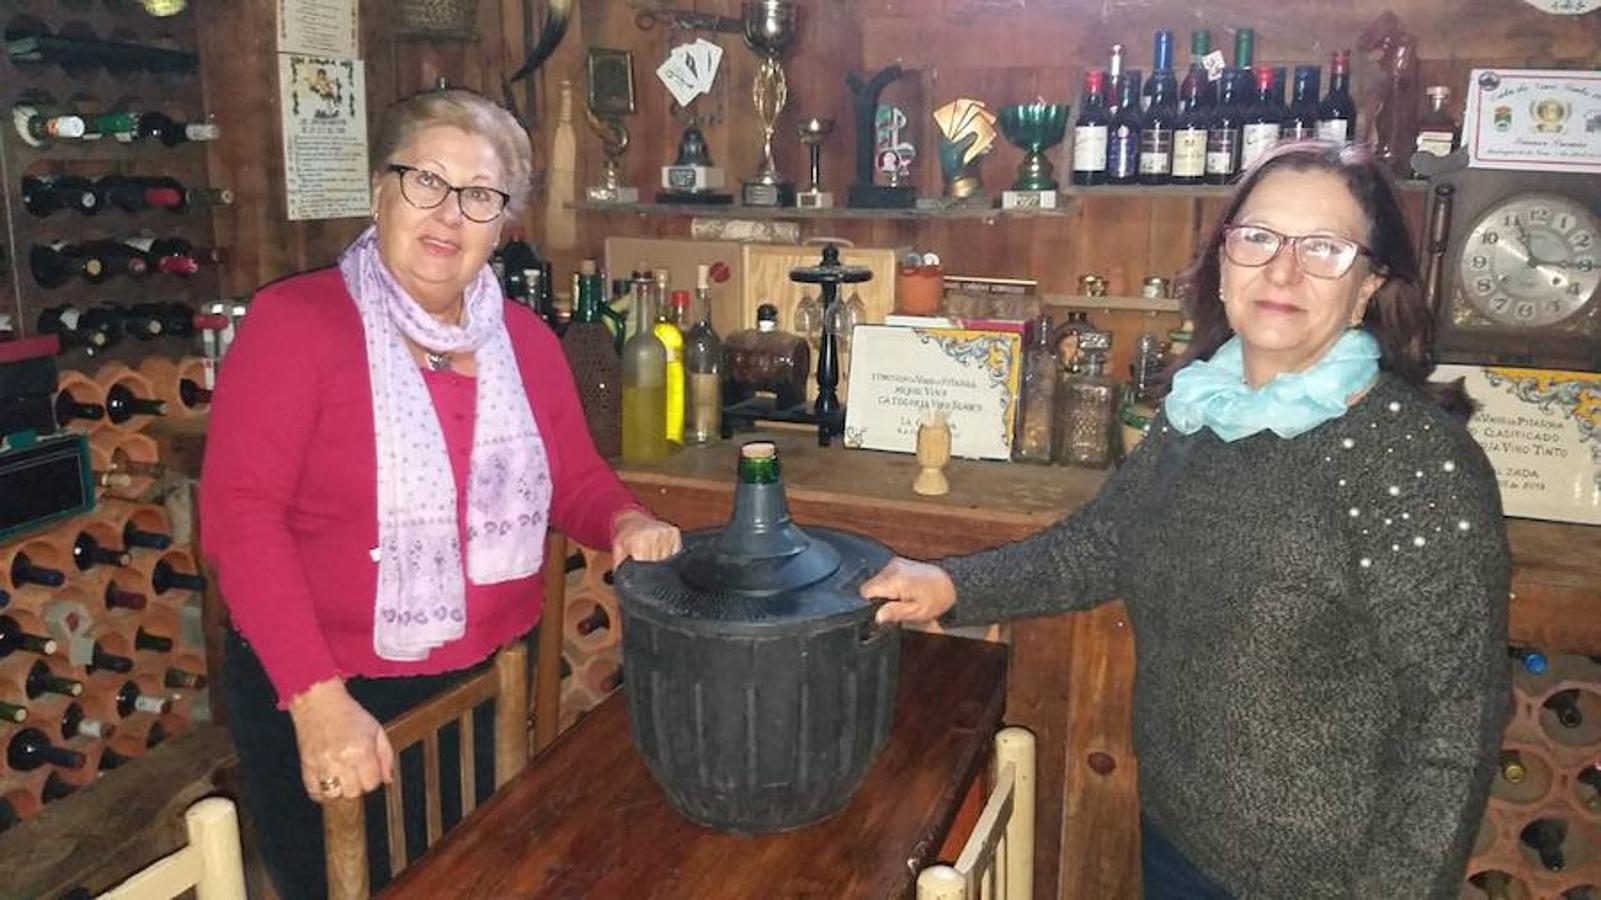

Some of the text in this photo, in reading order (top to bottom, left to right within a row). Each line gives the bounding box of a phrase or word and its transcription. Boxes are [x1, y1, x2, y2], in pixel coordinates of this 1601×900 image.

[1504, 215, 1520, 227] 11
[1529, 209, 1548, 222] 12
[1559, 217, 1567, 229] 1
[1481, 232, 1499, 244] 10
[1577, 233, 1590, 247] 2
[1472, 256, 1486, 269] 9
[1477, 279, 1491, 292] 8
[1567, 283, 1580, 295] 4
[1495, 299, 1507, 310] 7
[1518, 304, 1533, 317] 6
[1484, 427, 1560, 442] CLASIFICADO
[1502, 442, 1531, 455] VINO
[1533, 444, 1569, 459] TINTO
